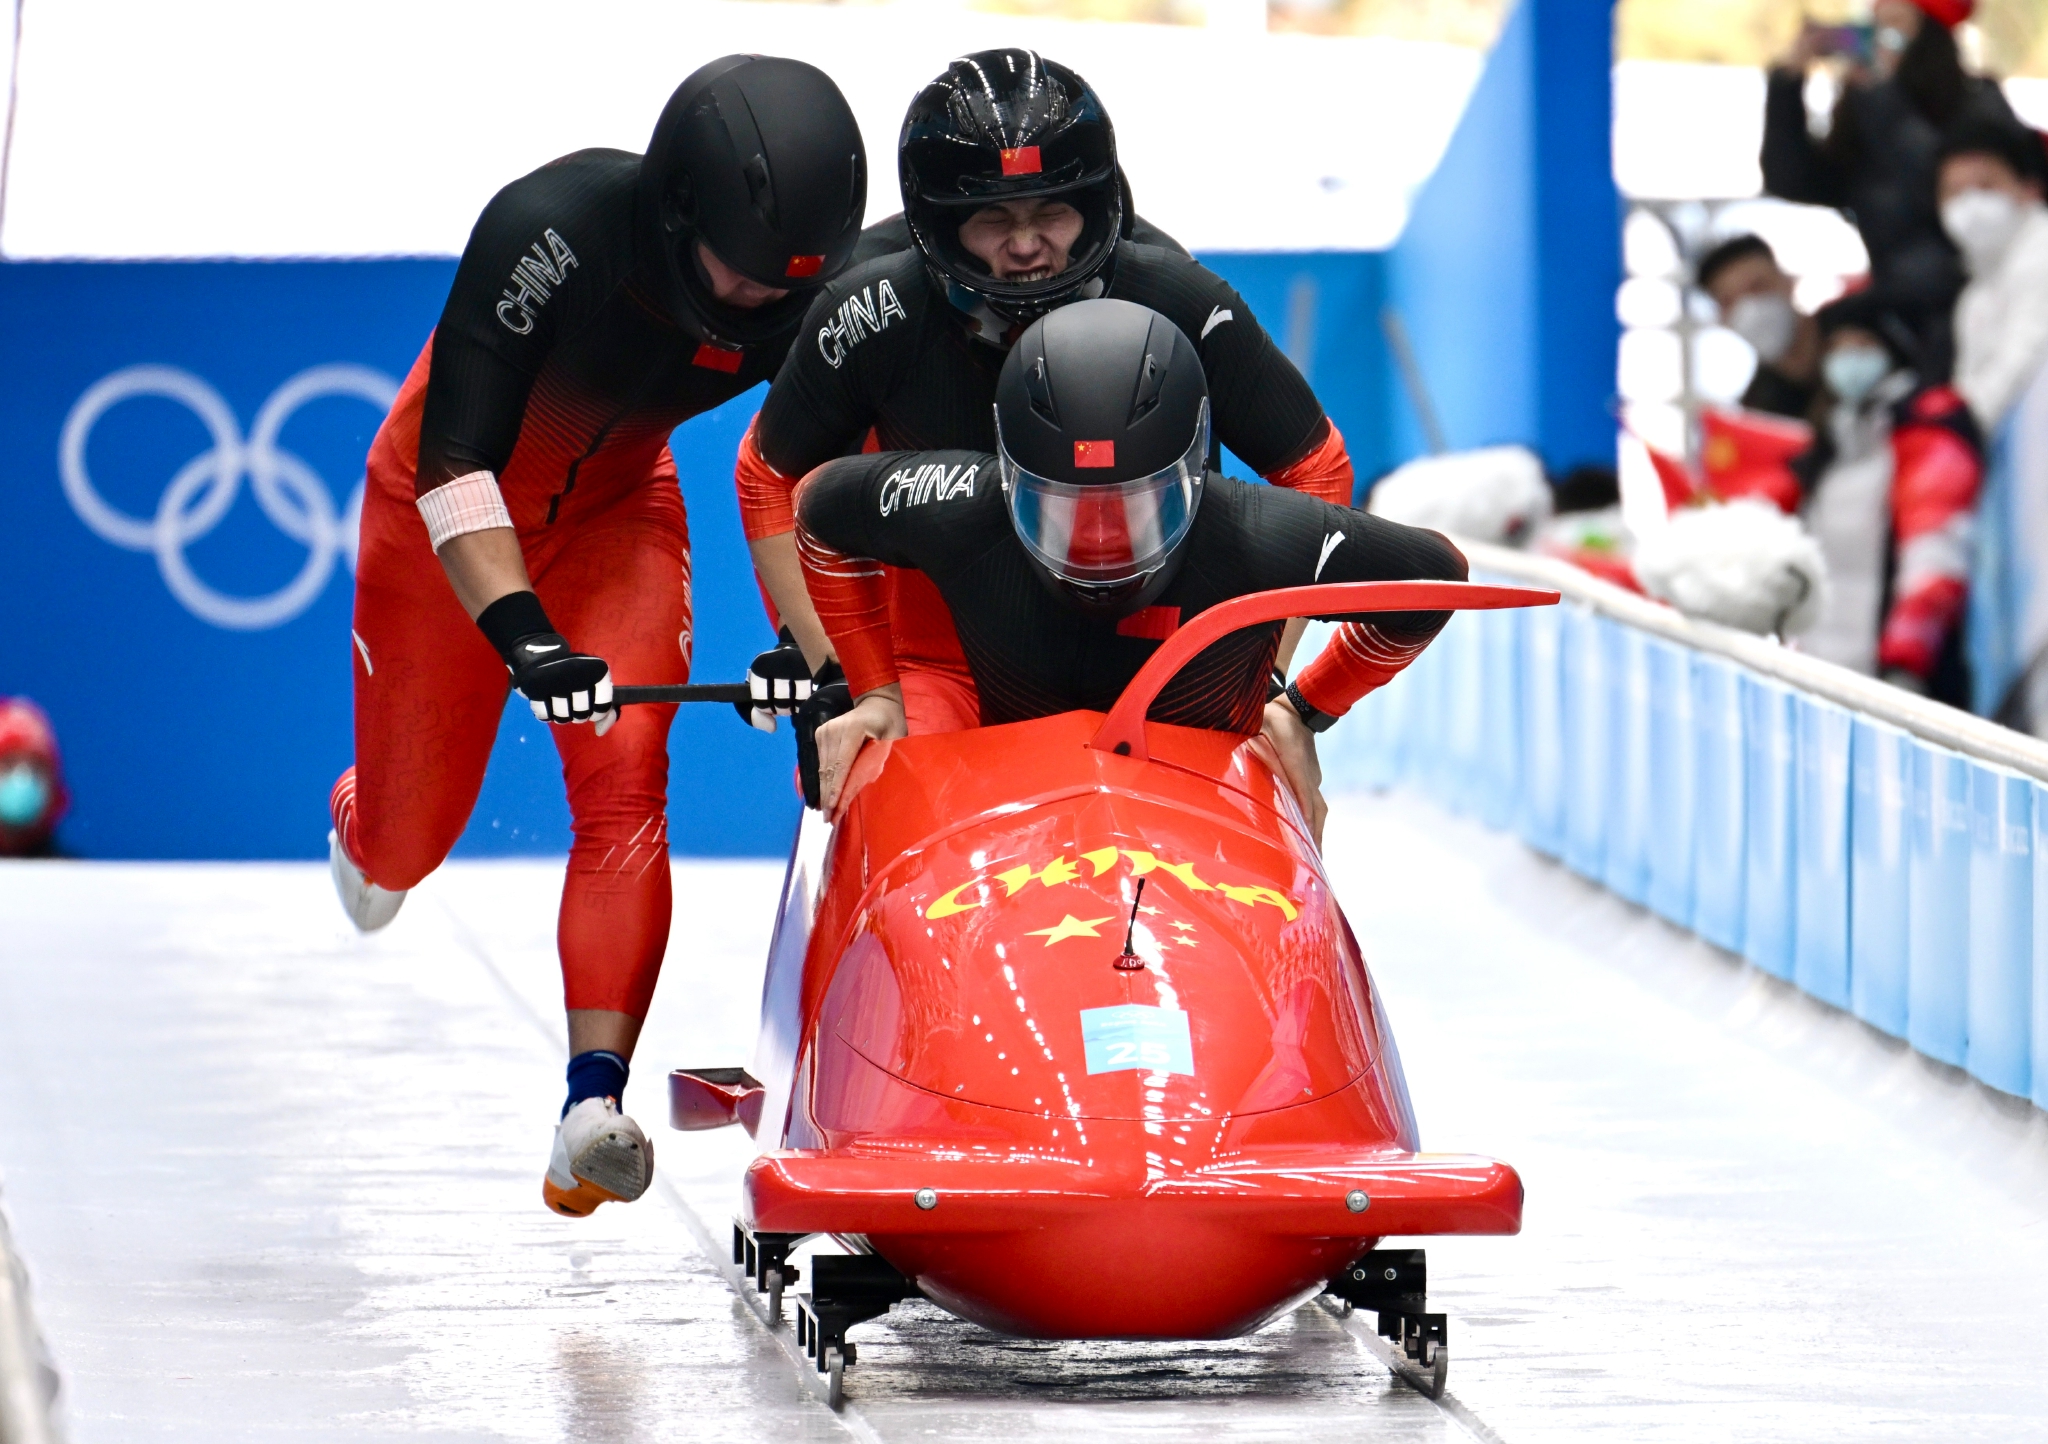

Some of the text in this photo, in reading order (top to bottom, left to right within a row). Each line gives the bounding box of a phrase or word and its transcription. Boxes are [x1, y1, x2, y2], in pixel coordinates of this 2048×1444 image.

[496, 228, 579, 335] CHINA
[818, 279, 906, 369] CHINA
[880, 464, 979, 517] CHINA
[1106, 1043, 1170, 1064] 25
